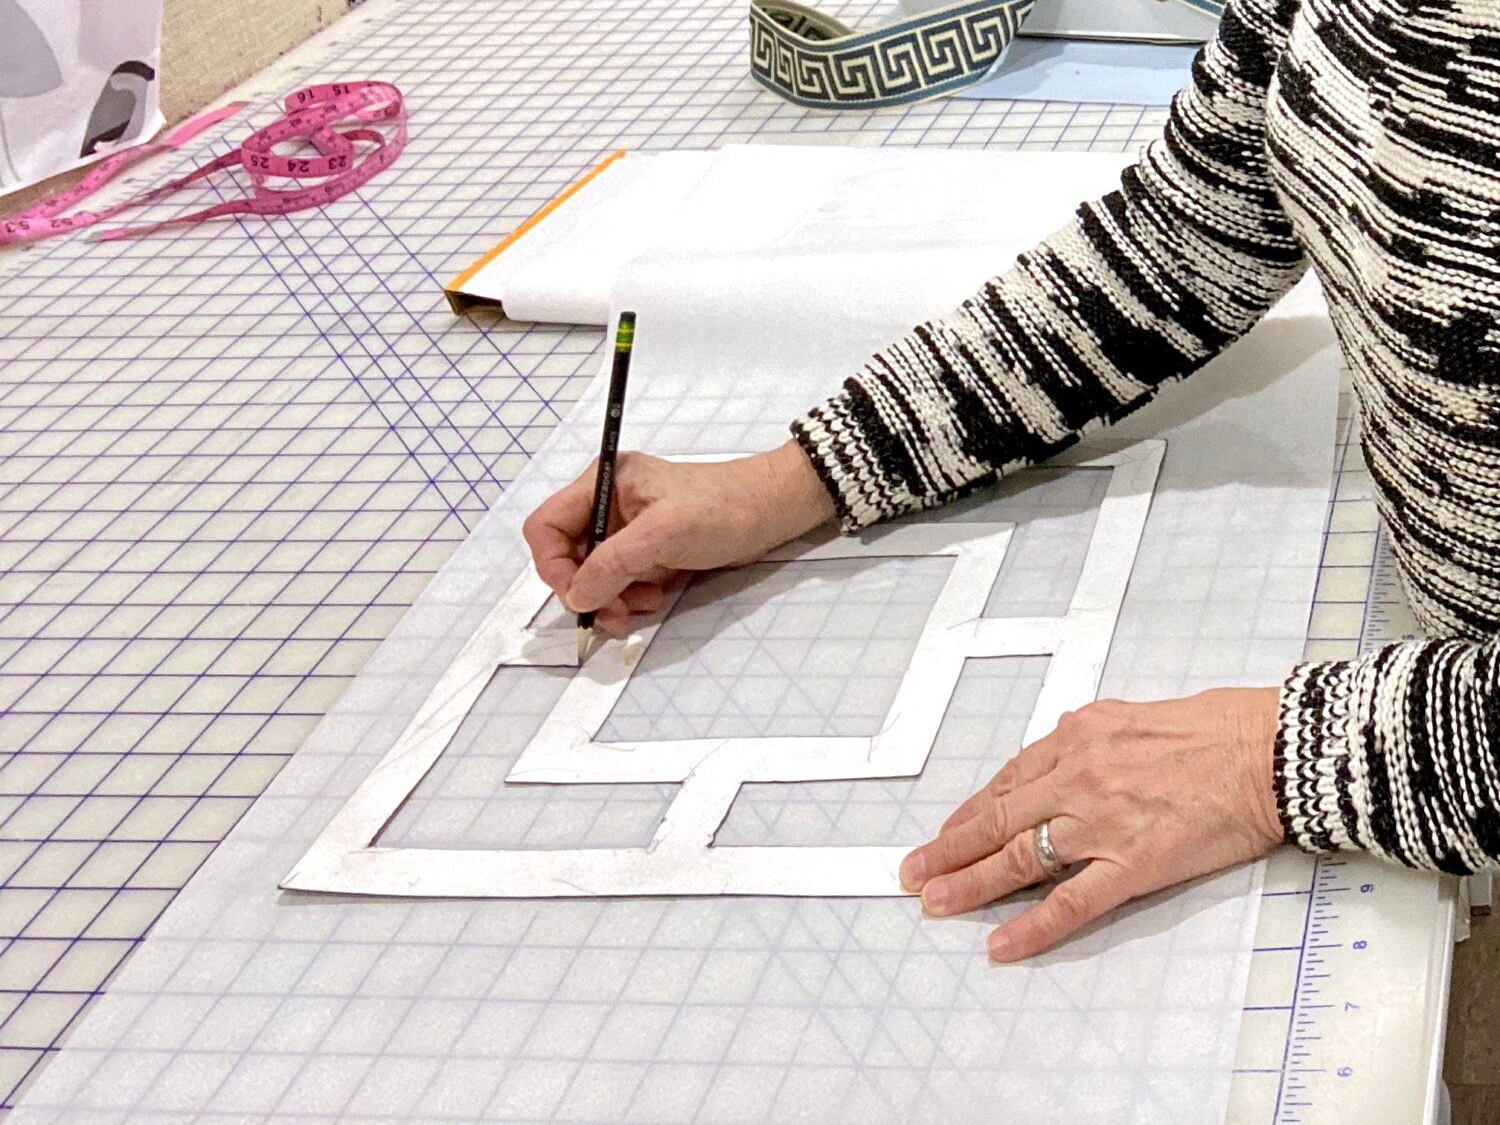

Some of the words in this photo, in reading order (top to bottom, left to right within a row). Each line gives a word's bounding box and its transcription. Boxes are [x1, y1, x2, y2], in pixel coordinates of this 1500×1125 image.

[297, 88, 315, 103] 16
[332, 84, 350, 96] 15
[250, 154, 270, 169] 25
[287, 159, 310, 173] 24
[328, 155, 347, 170] 23
[6, 220, 30, 233] 53
[51, 217, 73, 228] 52
[1360, 883, 1375, 894] 9
[1352, 939, 1368, 950] 8
[1344, 1001, 1360, 1012] 7
[1337, 1066, 1353, 1078] 6
